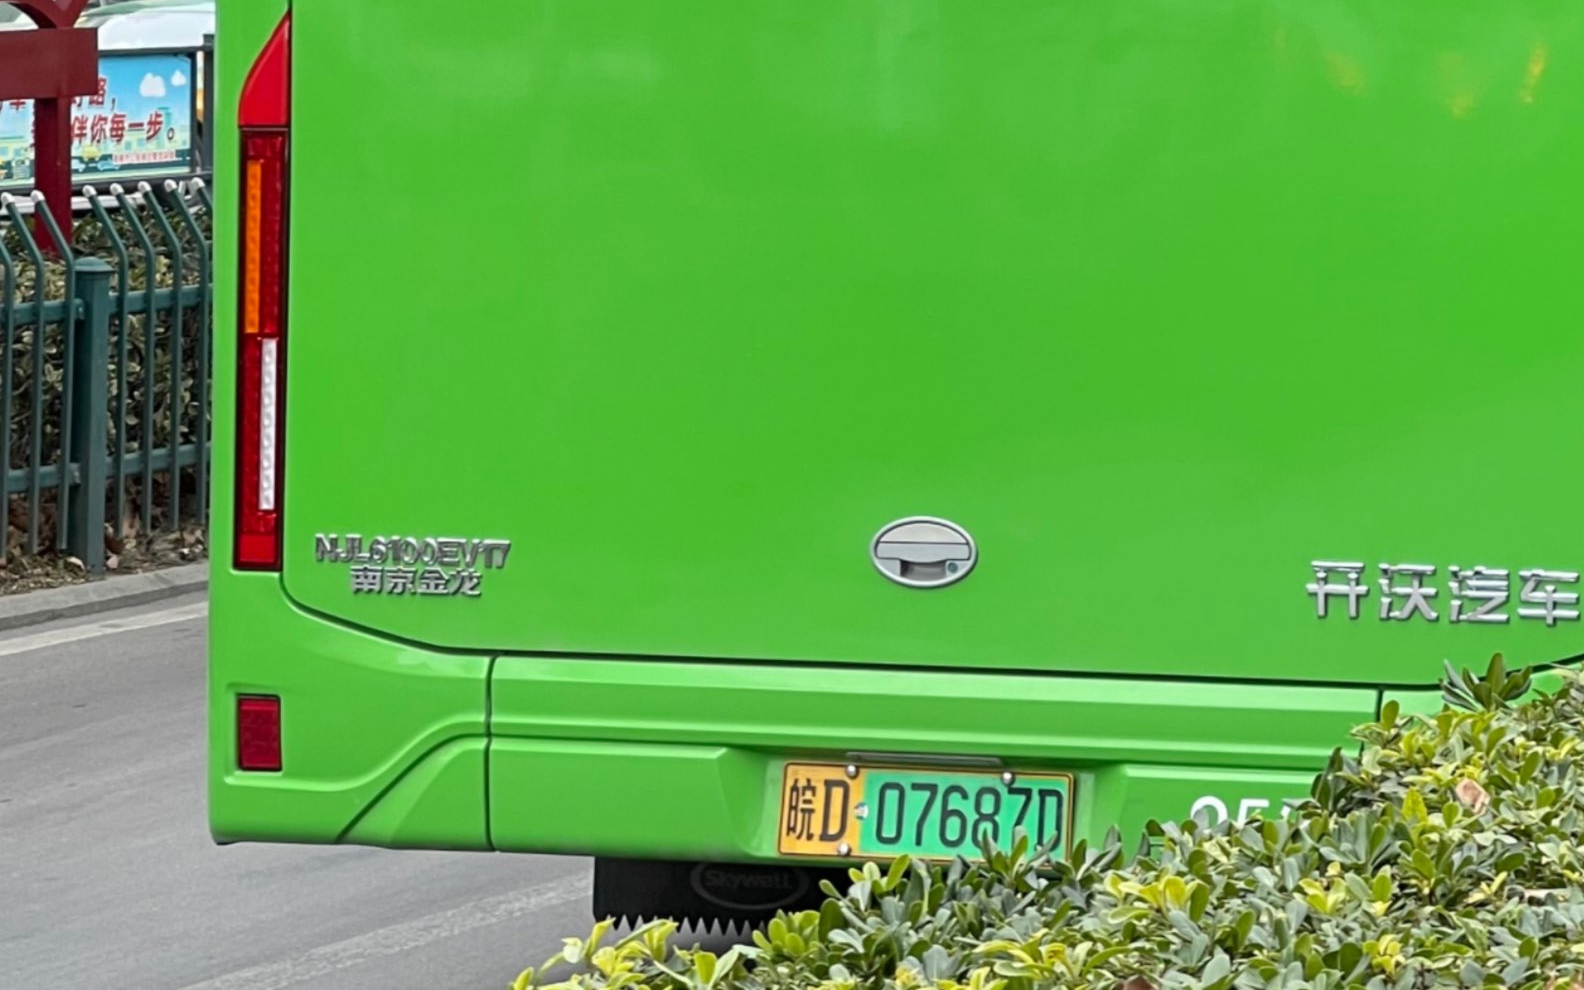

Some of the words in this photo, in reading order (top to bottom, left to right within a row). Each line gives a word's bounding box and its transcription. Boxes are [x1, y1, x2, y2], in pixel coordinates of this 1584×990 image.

[315, 533, 511, 569] NJL6100EV17
[350, 565, 483, 597] 南京金龙
[1306, 560, 1580, 626] 开沃汽车
